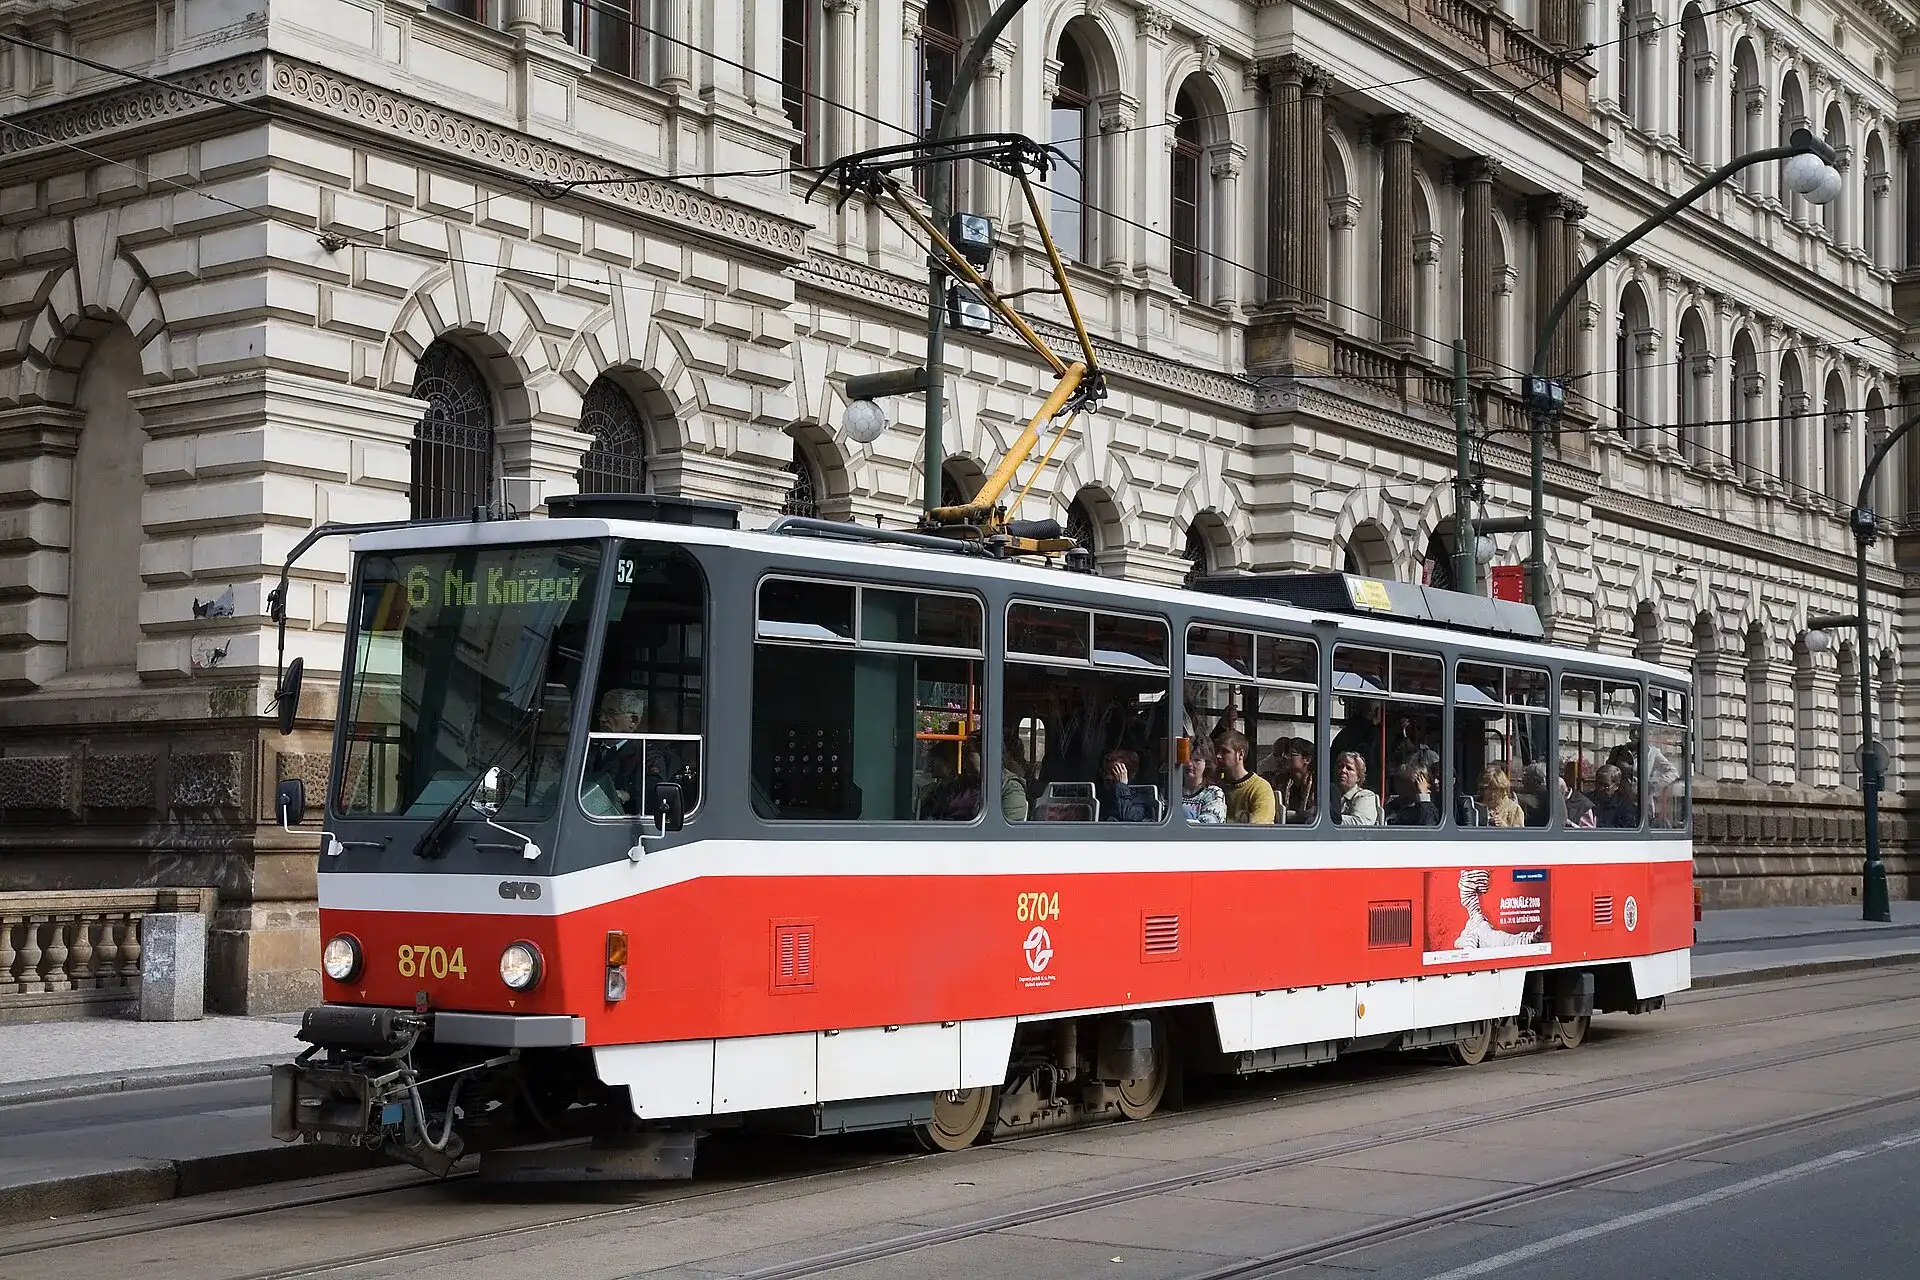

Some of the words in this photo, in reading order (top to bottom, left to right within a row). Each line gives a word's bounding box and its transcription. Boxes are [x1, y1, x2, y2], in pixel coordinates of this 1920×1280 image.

[407, 565, 430, 608] 6
[444, 569, 478, 606] Na
[487, 567, 581, 604] Knížecí
[617, 560, 634, 583] 52
[1016, 891, 1060, 922] 8704
[397, 944, 467, 980] 8704
